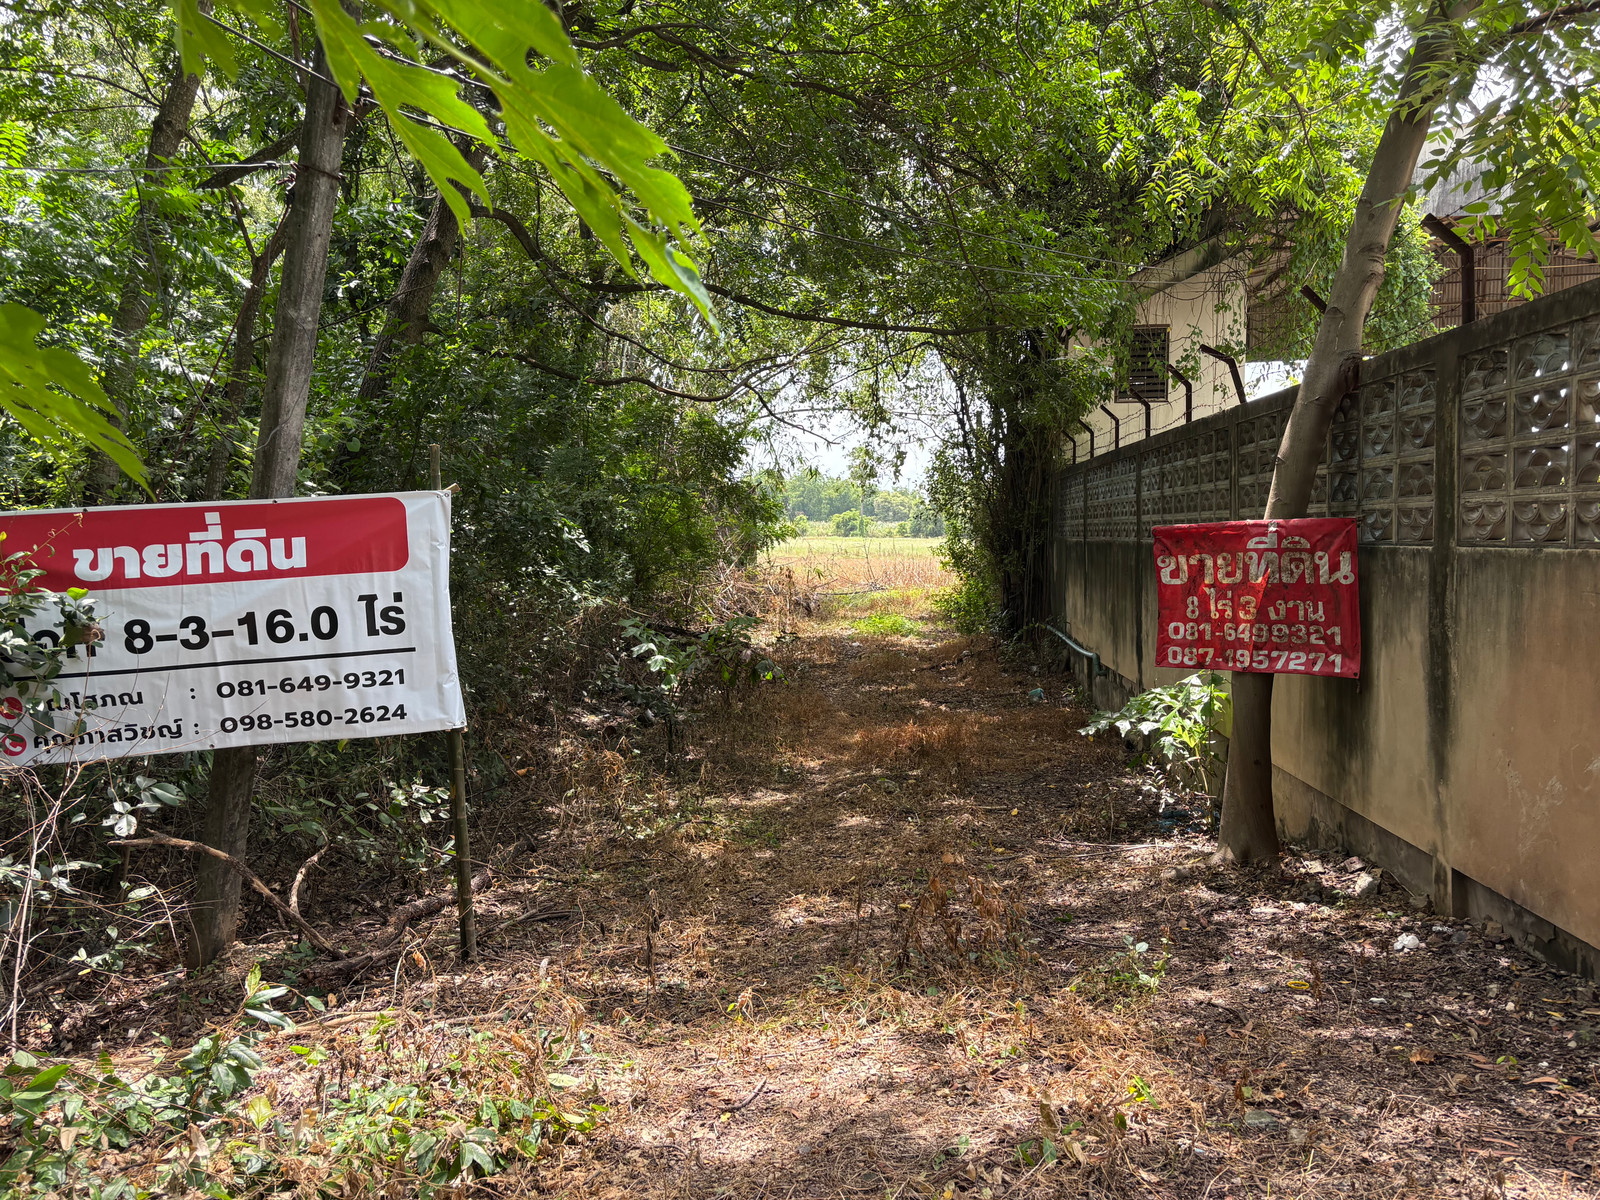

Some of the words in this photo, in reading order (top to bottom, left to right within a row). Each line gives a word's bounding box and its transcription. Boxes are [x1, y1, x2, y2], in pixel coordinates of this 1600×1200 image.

[73, 511, 307, 582] ขายที่ดิน
[1157, 520, 1355, 585] ขายที่ดิน
[124, 605, 340, 655] 8-3-16.0
[358, 592, 407, 637] ไร่
[1186, 596, 1199, 619] 8
[1239, 595, 1257, 620] 3
[1267, 599, 1326, 622] งาน
[1168, 622, 1342, 646] 081-6499321
[1167, 646, 1342, 673] 087-1957271
[216, 668, 406, 699] 081-649-9321
[220, 704, 408, 734] 098-580-2624
